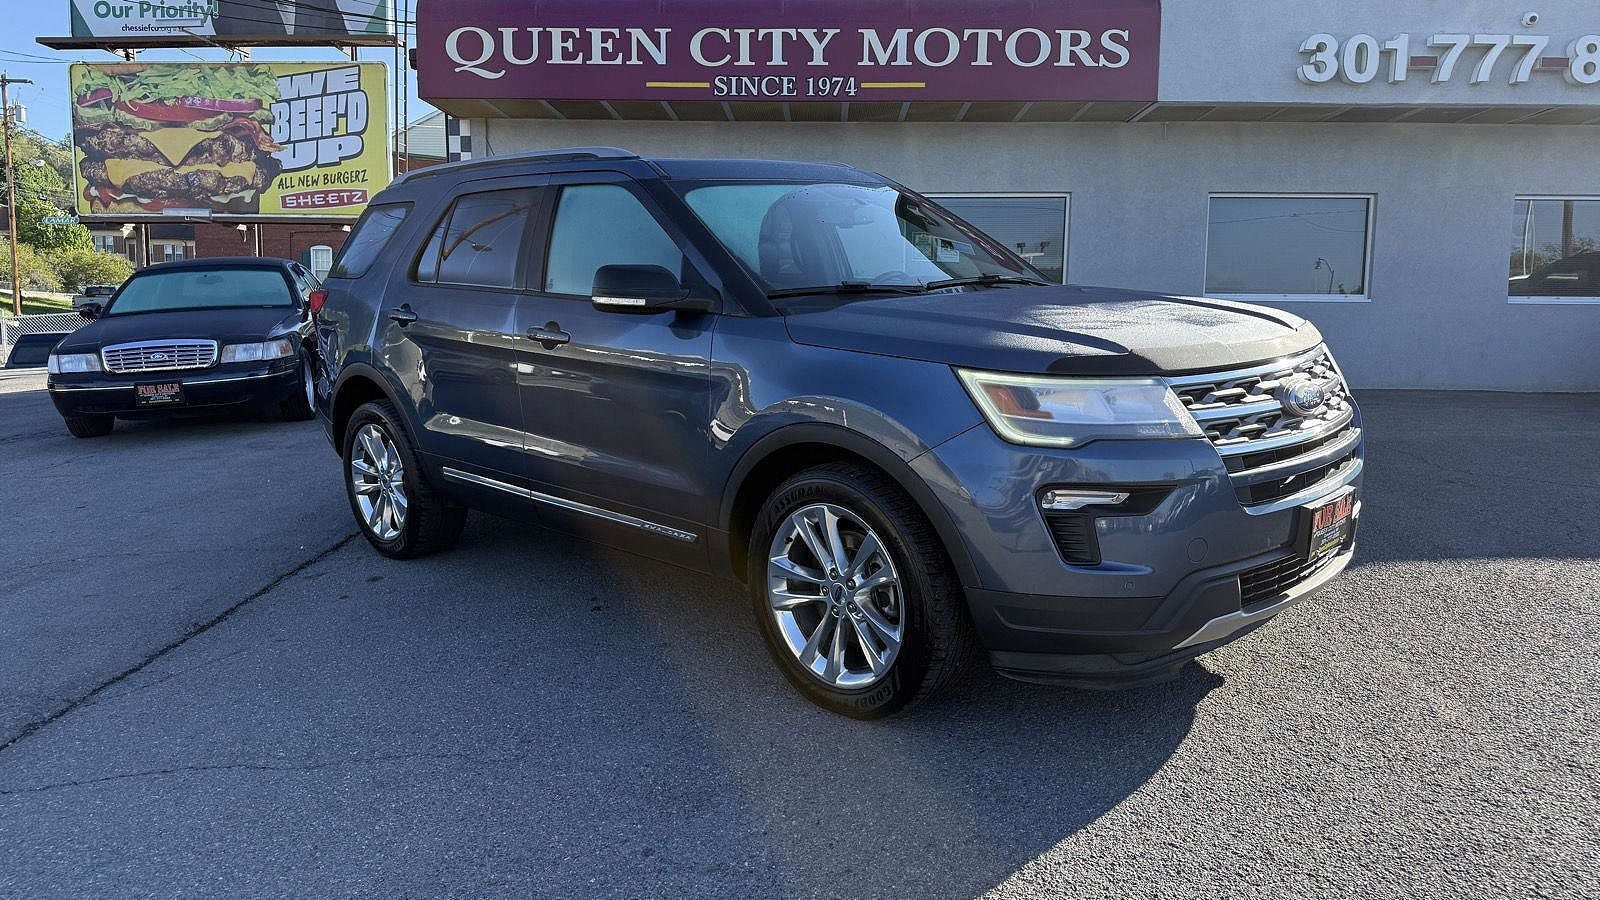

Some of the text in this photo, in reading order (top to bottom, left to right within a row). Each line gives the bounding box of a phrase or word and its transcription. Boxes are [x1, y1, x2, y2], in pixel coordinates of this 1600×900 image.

[93, 0, 220, 27] Our Priority!
[445, 26, 1130, 79] QUEEN CITY MOTORS
[275, 65, 360, 101] WE
[713, 75, 858, 97] SINCE 1974
[270, 90, 369, 144] BEEF'D
[271, 134, 364, 173] UP
[278, 169, 369, 190] ALL NEW BURGERZ
[286, 191, 363, 207] SHEETZ
[137, 385, 157, 395] FOR
[1311, 503, 1334, 534] FOR
